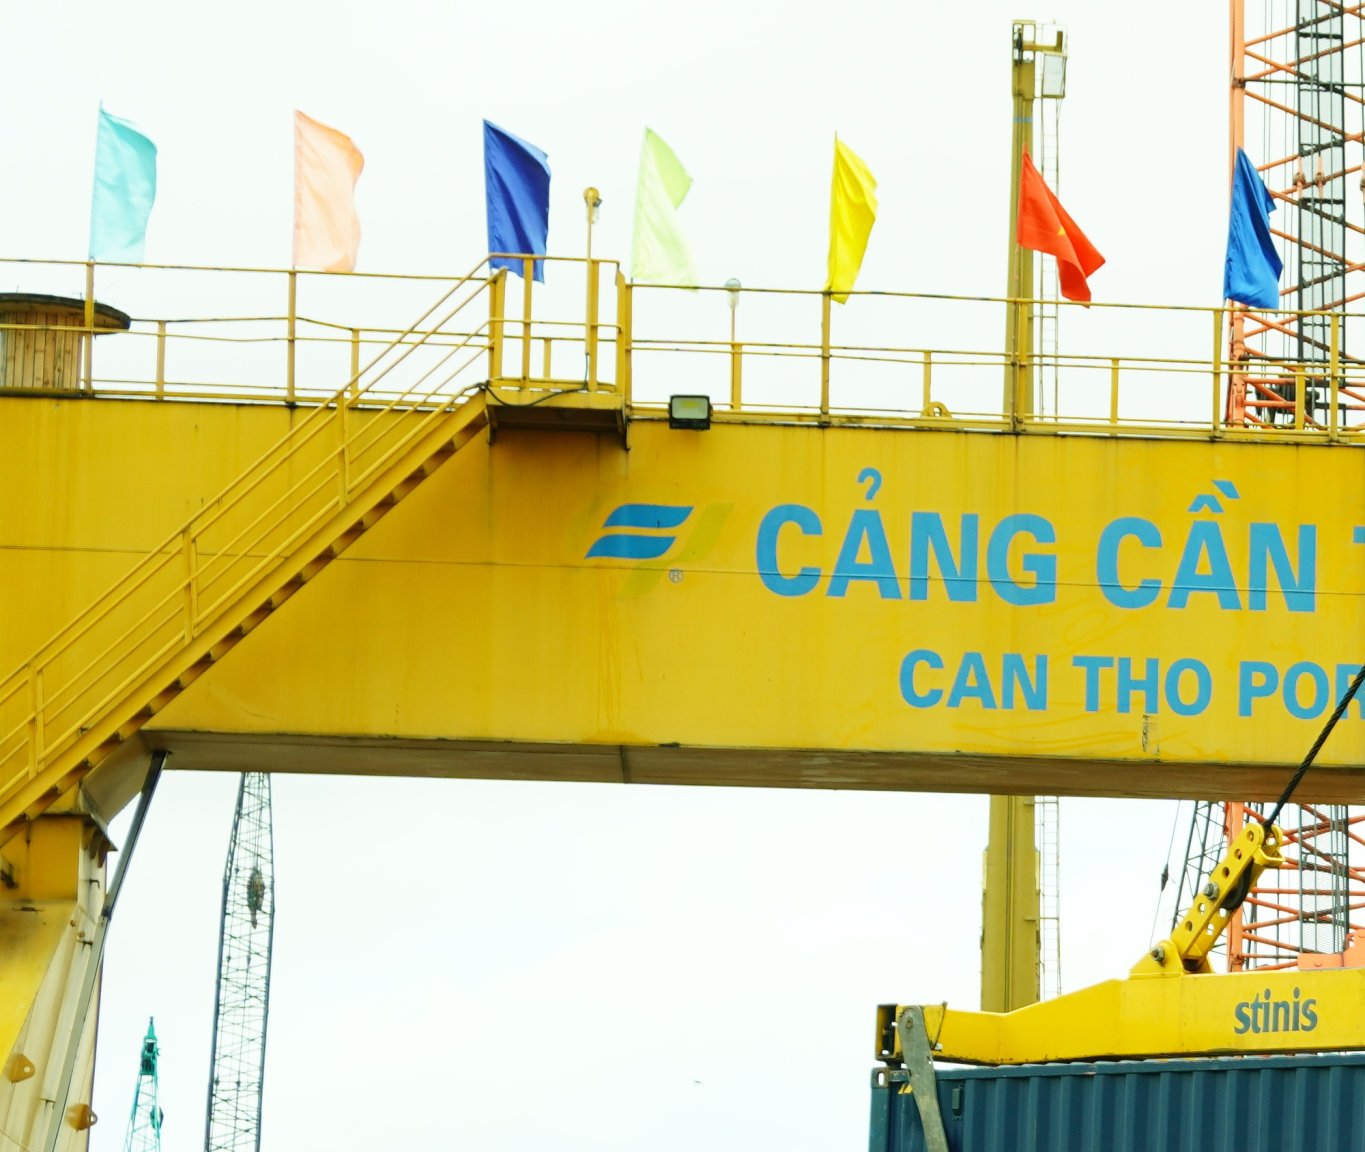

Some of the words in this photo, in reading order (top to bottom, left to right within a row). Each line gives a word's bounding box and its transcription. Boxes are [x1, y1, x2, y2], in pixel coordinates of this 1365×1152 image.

[757, 468, 1056, 606] CẢNG
[1097, 482, 1316, 611] CẦN
[900, 649, 1047, 709] CAN
[1073, 655, 1211, 715] THO
[1233, 987, 1319, 1035] stinis
